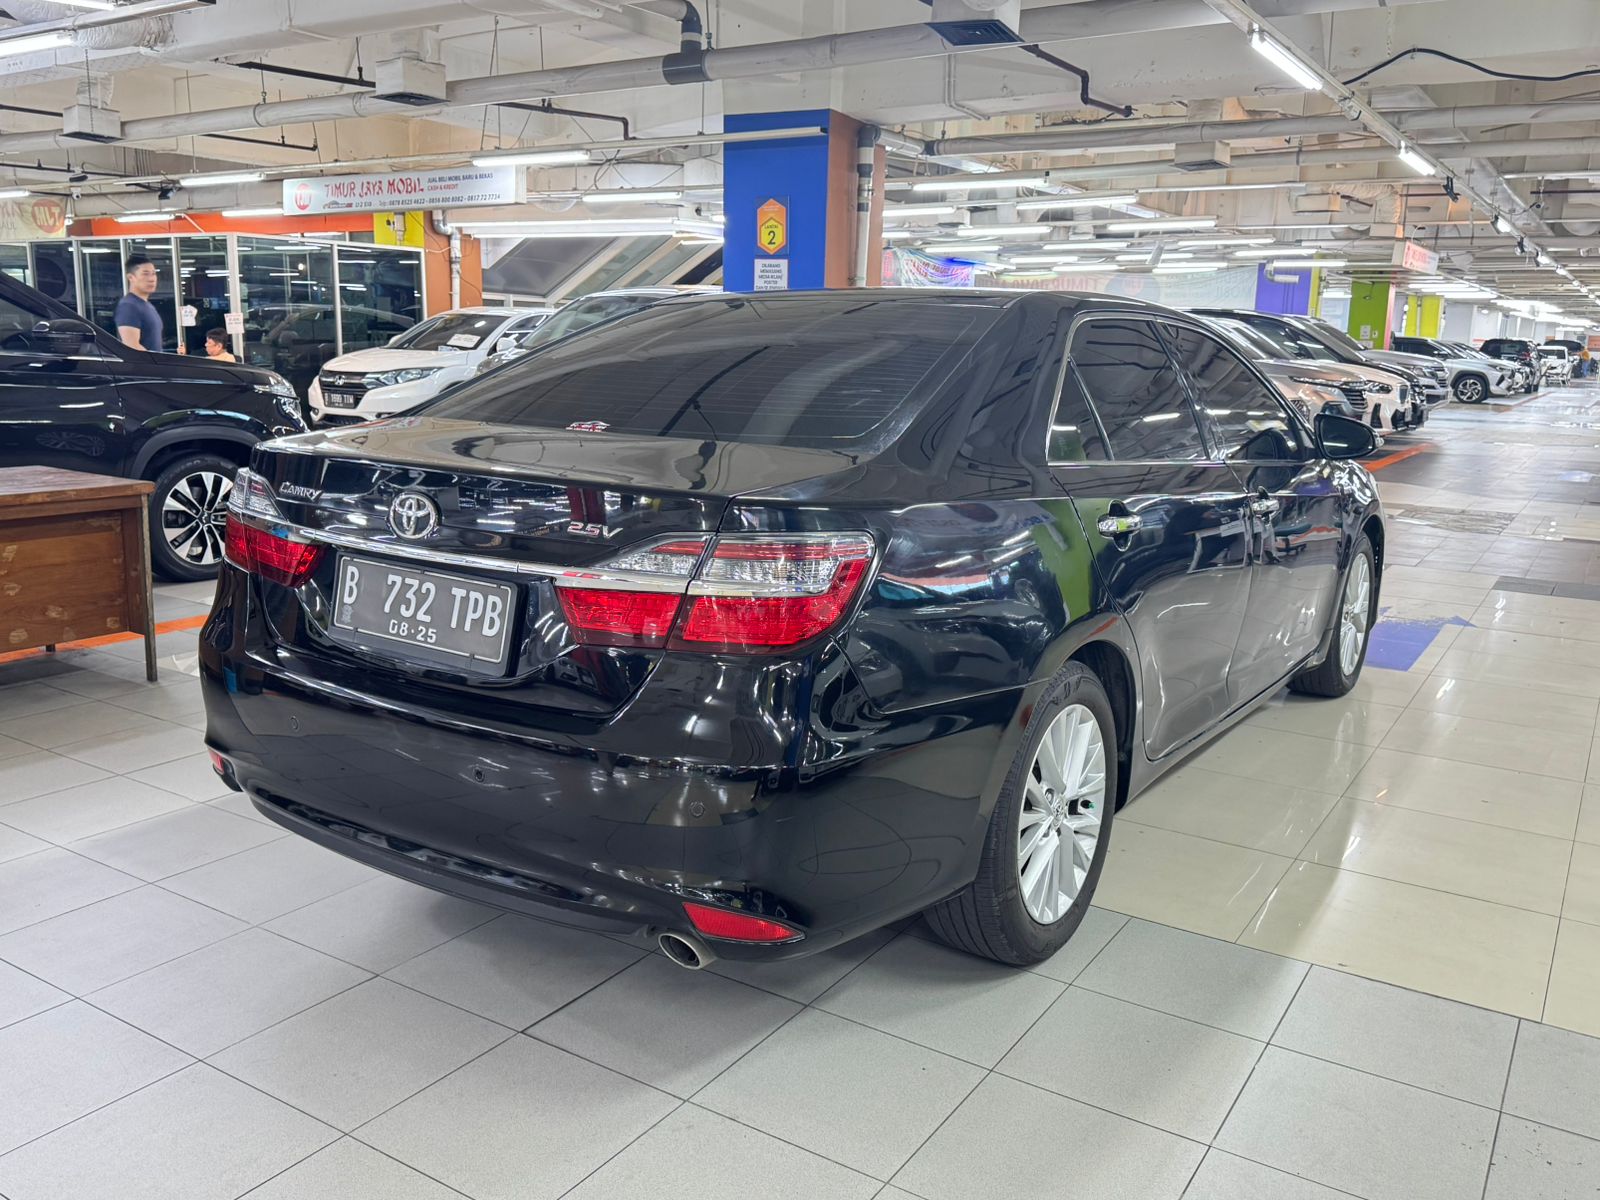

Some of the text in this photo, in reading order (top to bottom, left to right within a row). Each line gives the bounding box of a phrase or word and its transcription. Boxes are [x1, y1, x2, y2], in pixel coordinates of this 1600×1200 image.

[324, 181, 356, 200] TIMUR
[359, 180, 384, 198] JAYA
[386, 177, 424, 195] MOBIL
[767, 230, 776, 245] 2
[279, 481, 324, 502] CAMRY
[343, 565, 502, 637] B 732 TPB
